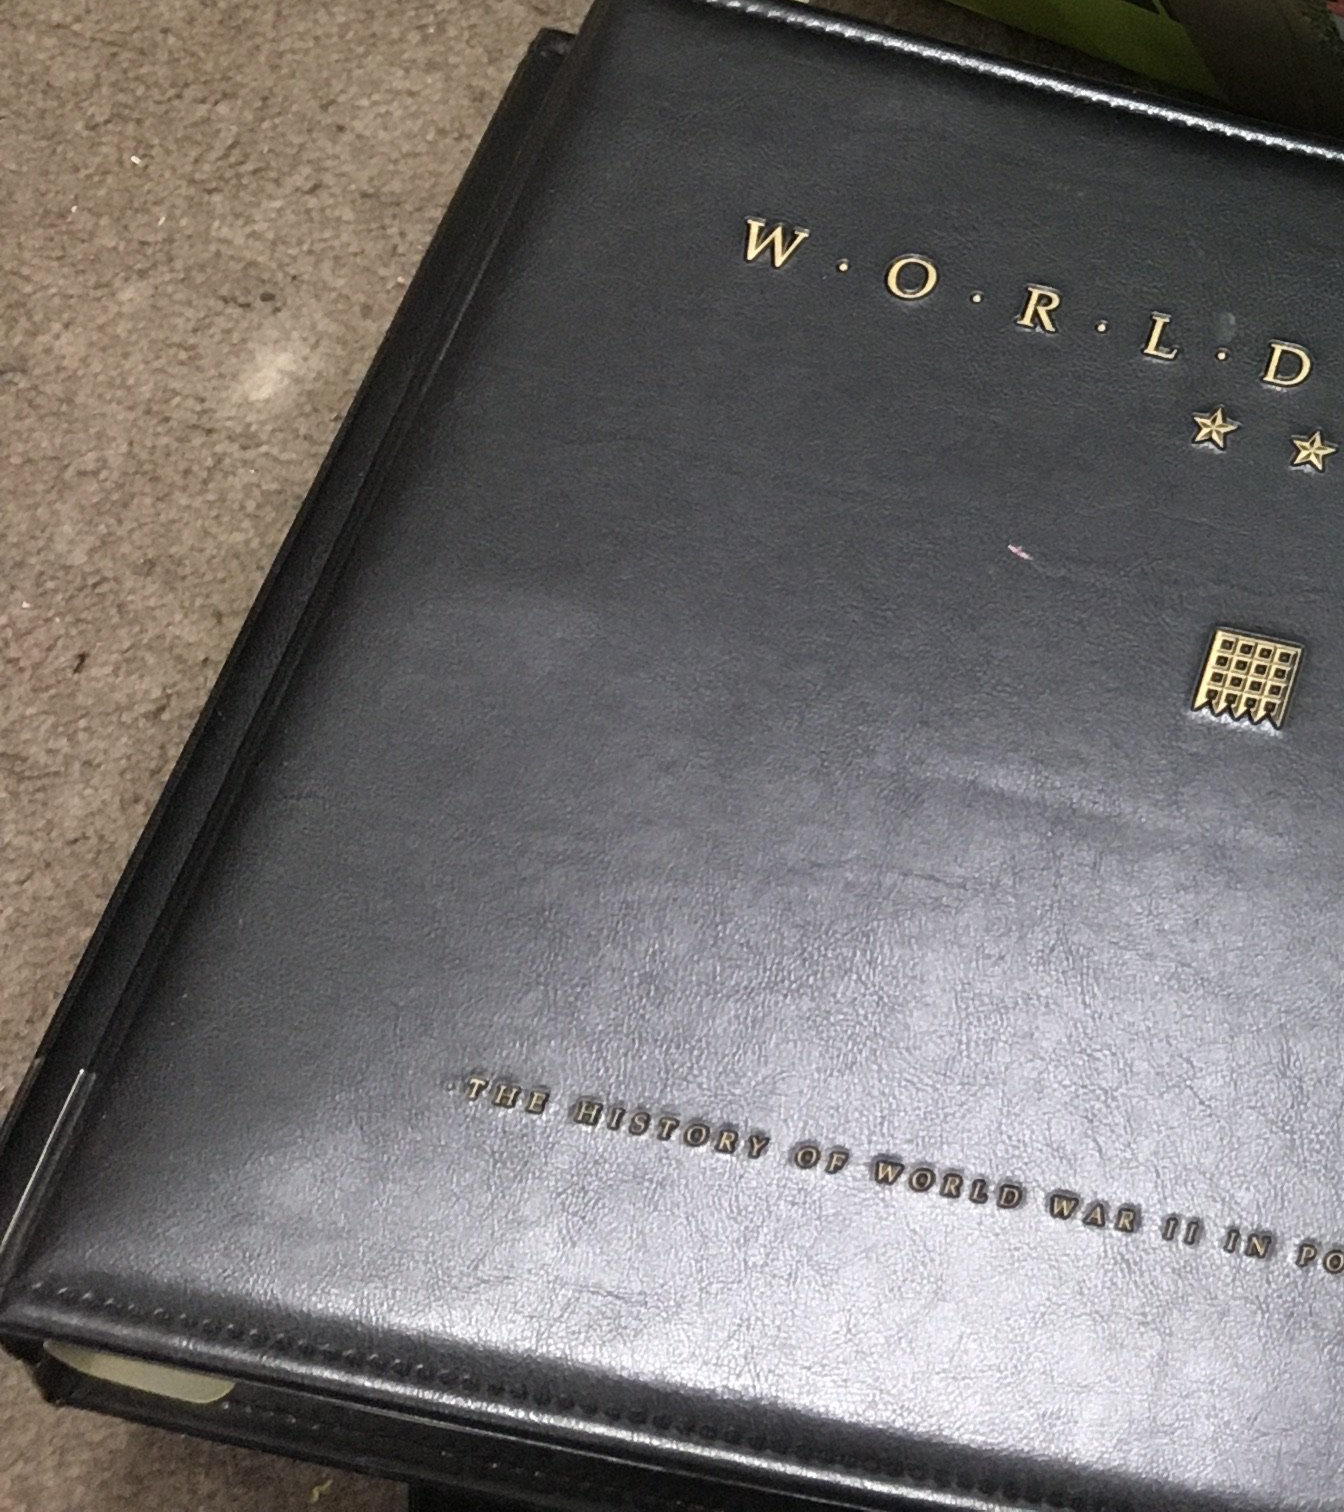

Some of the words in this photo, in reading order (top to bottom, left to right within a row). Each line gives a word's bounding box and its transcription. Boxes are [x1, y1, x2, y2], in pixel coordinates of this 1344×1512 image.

[466, 1076, 551, 1116] THE
[573, 1098, 770, 1160] HISTORY
[793, 1145, 850, 1175] OF
[874, 1159, 1025, 1210] WORLD
[1047, 1193, 1140, 1235] WAR
[1160, 1216, 1201, 1246] II
[1223, 1229, 1274, 1259] IN
